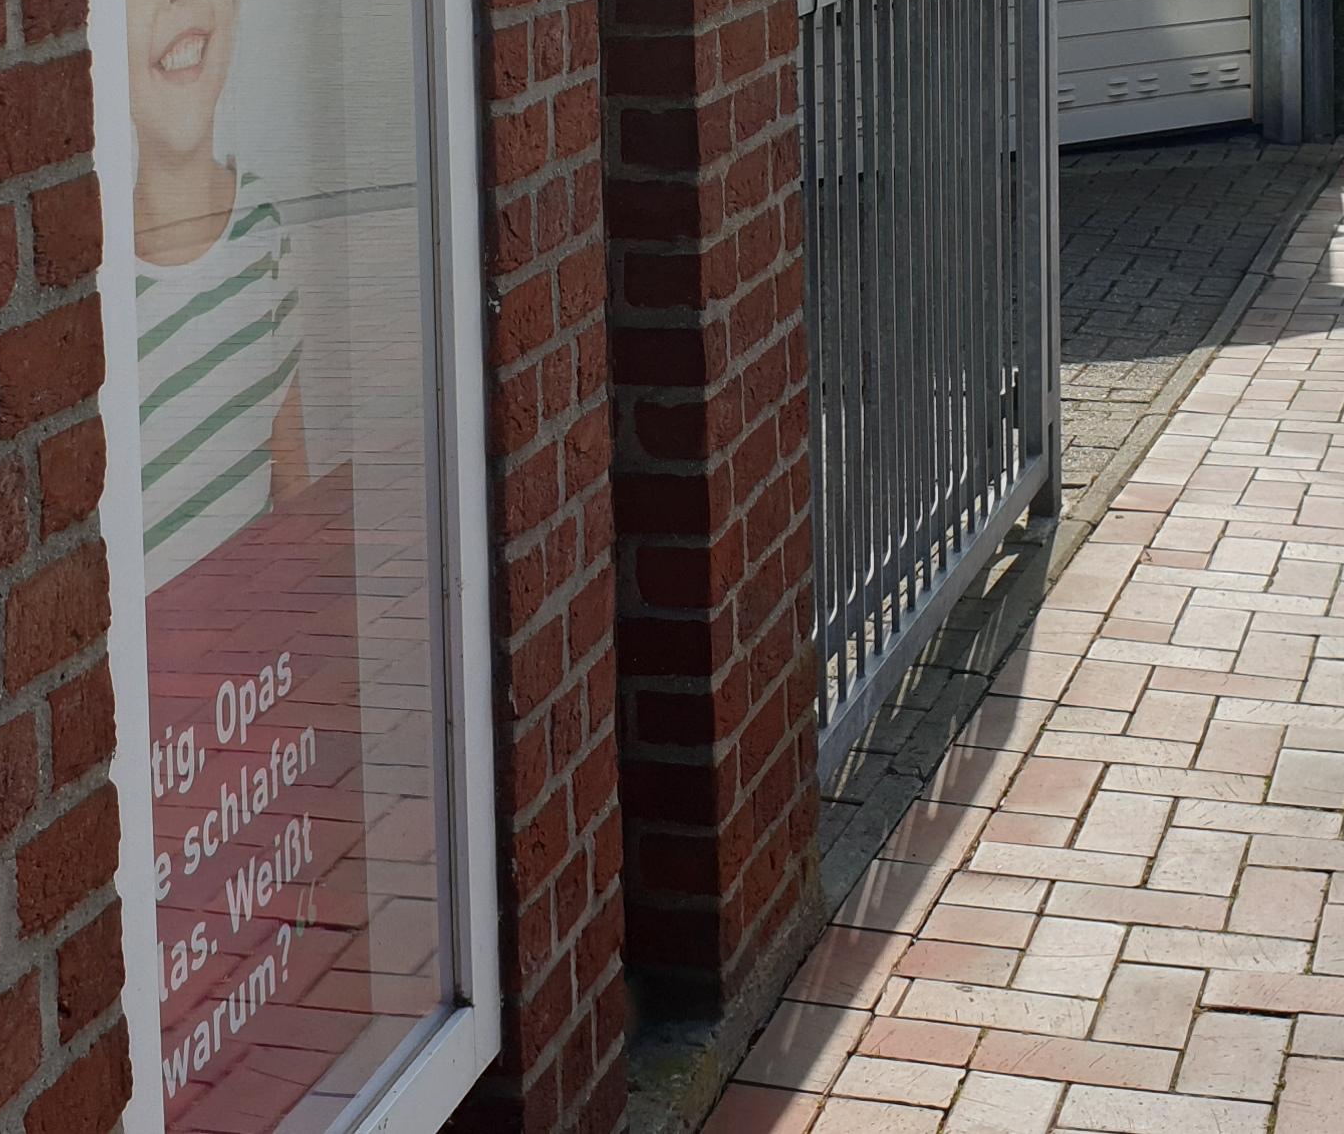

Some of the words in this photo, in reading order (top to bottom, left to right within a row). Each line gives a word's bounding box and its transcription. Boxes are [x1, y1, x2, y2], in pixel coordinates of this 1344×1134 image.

[215, 652, 292, 743] Opas
[183, 726, 316, 875] schlafen
[226, 811, 313, 934] Weißt
